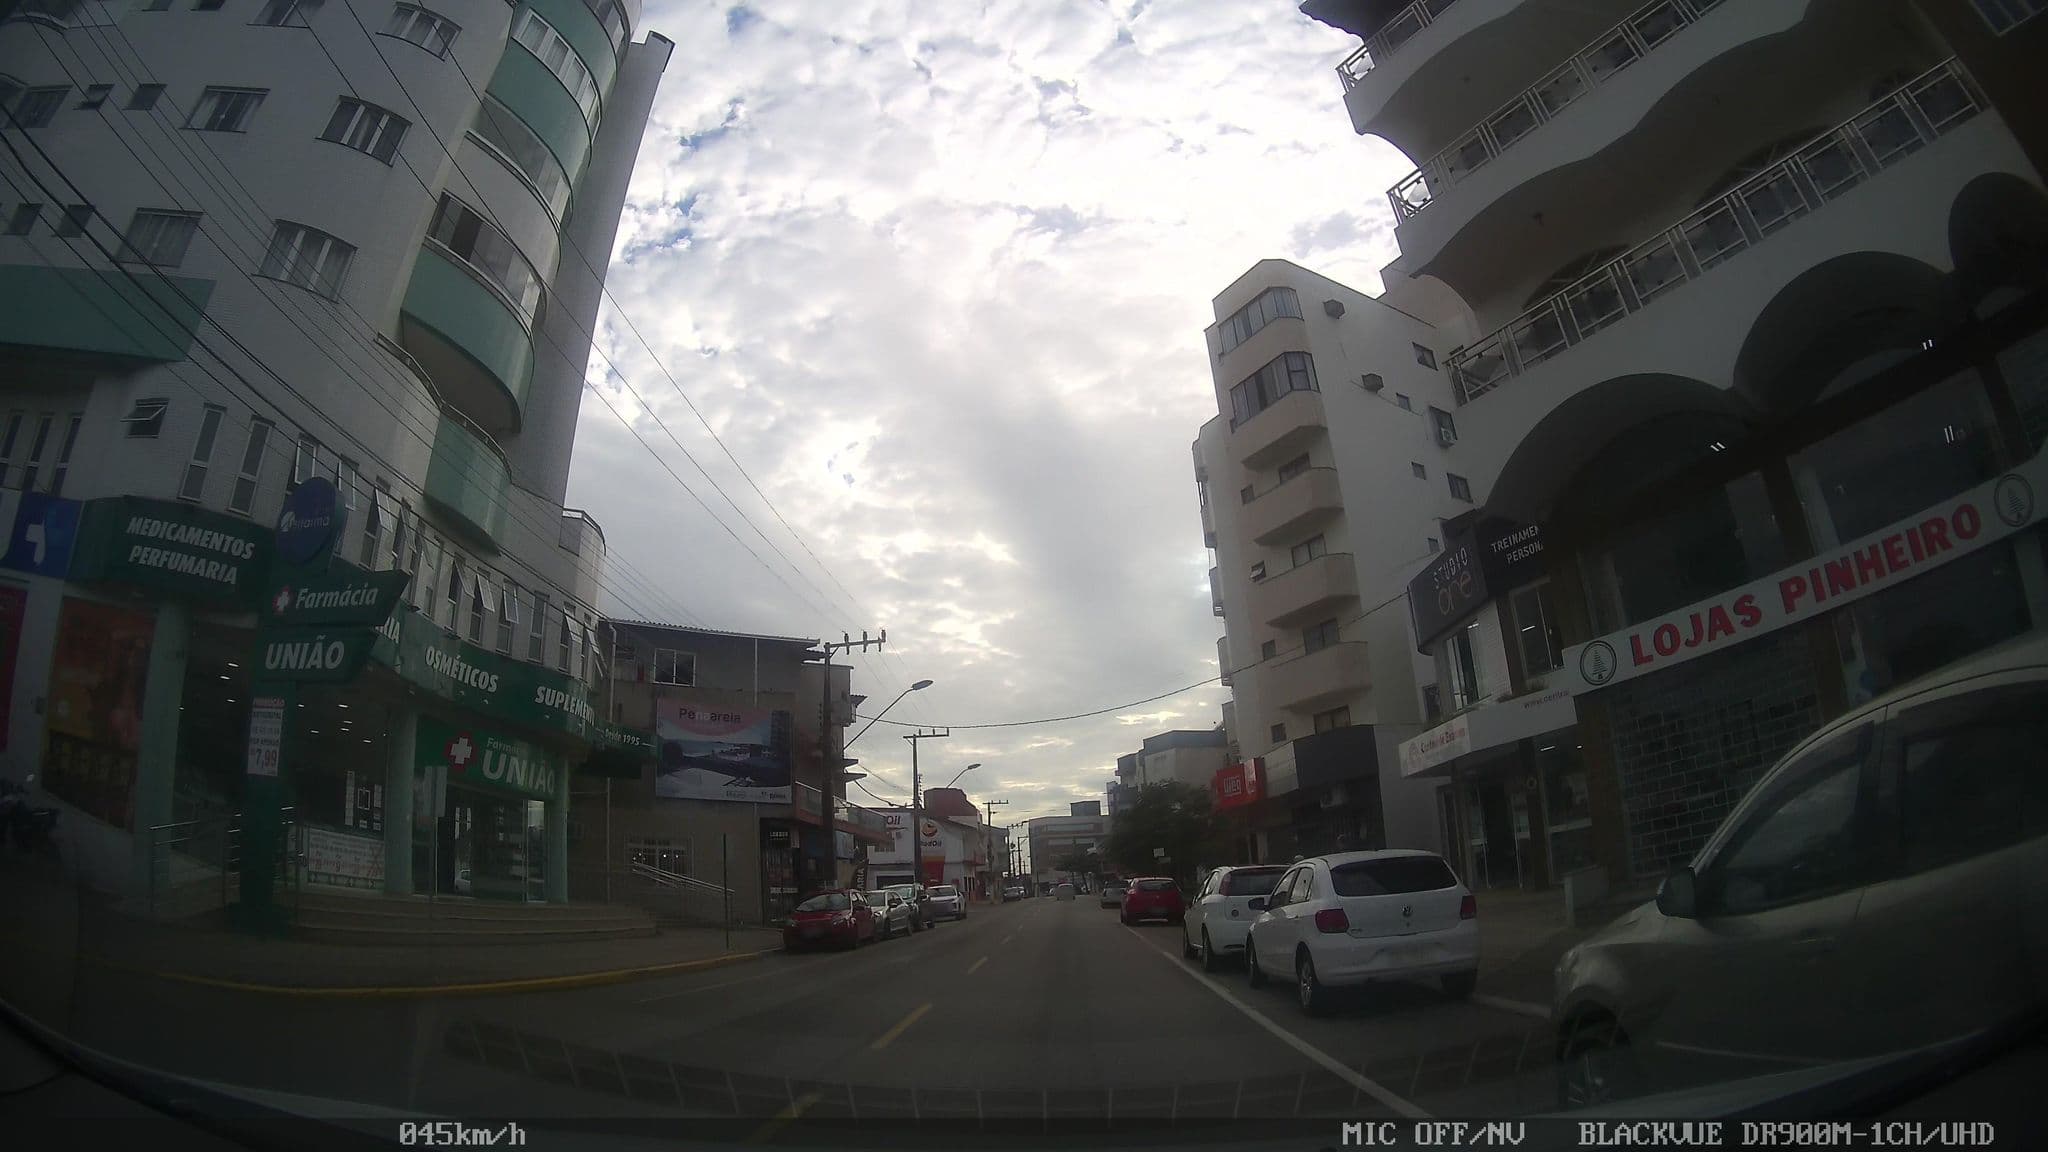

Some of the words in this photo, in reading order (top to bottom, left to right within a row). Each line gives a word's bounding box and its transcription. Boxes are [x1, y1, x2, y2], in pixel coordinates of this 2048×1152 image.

[126, 516, 256, 560] MEDICAMENTOS
[127, 545, 238, 585] PERFUMARIA
[295, 582, 379, 609] Farmácia
[1629, 594, 1763, 668] LOJAS
[1778, 503, 1982, 615] PINHEIRO
[265, 634, 345, 670] UNIÃO
[623, 734, 641, 746] 1995
[481, 749, 556, 794] UNIÃO
